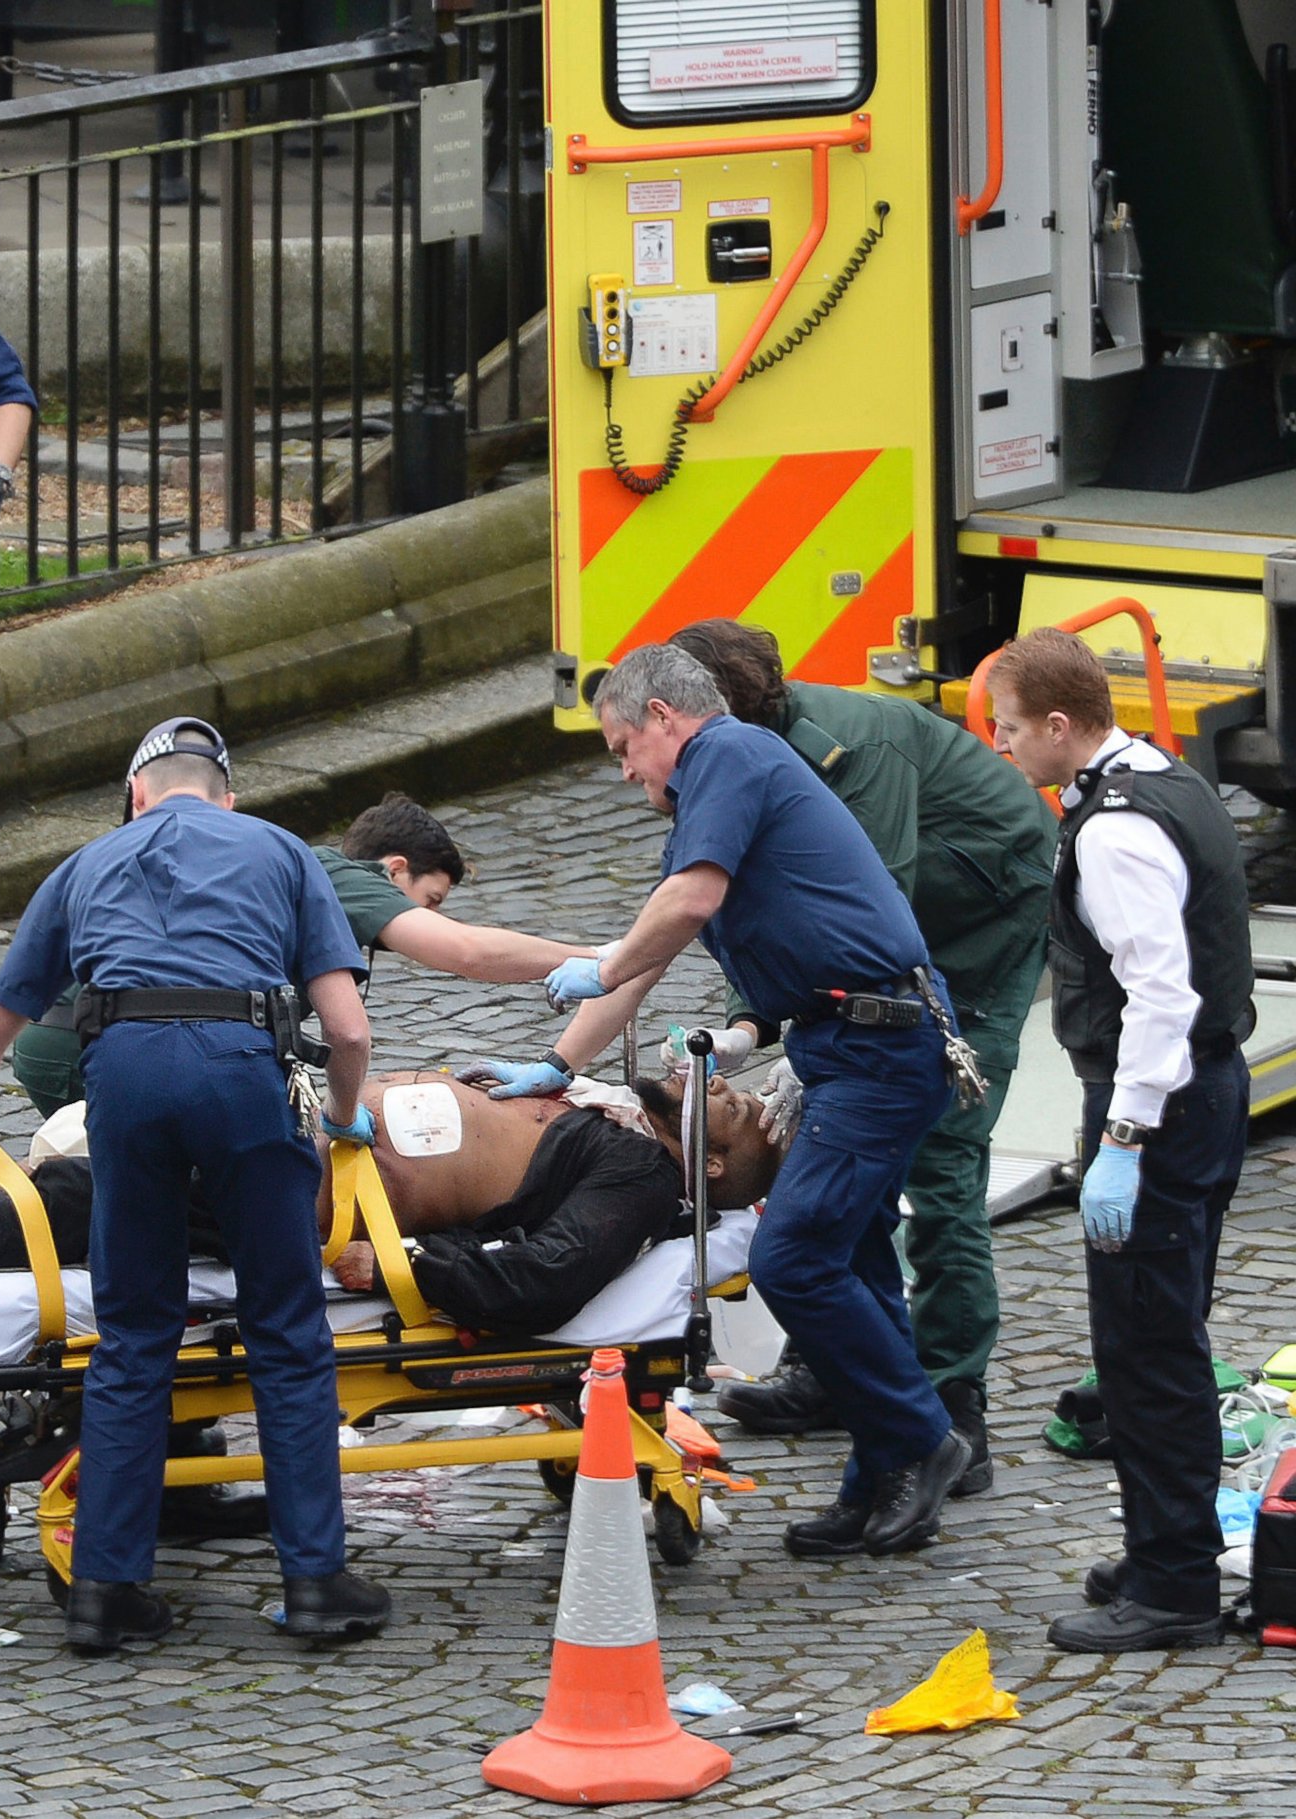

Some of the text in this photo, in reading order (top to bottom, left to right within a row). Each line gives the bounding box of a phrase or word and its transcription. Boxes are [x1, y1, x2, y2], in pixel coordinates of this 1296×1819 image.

[685, 62, 709, 71] HOLD
[710, 60, 734, 69] HAND
[736, 59, 759, 68] RAILS
[770, 55, 802, 65] CENTRE
[655, 65, 833, 85] RISK OF PINCH POINT WHEN CLOSING DOORS
[1087, 79, 1096, 135] FERNO
